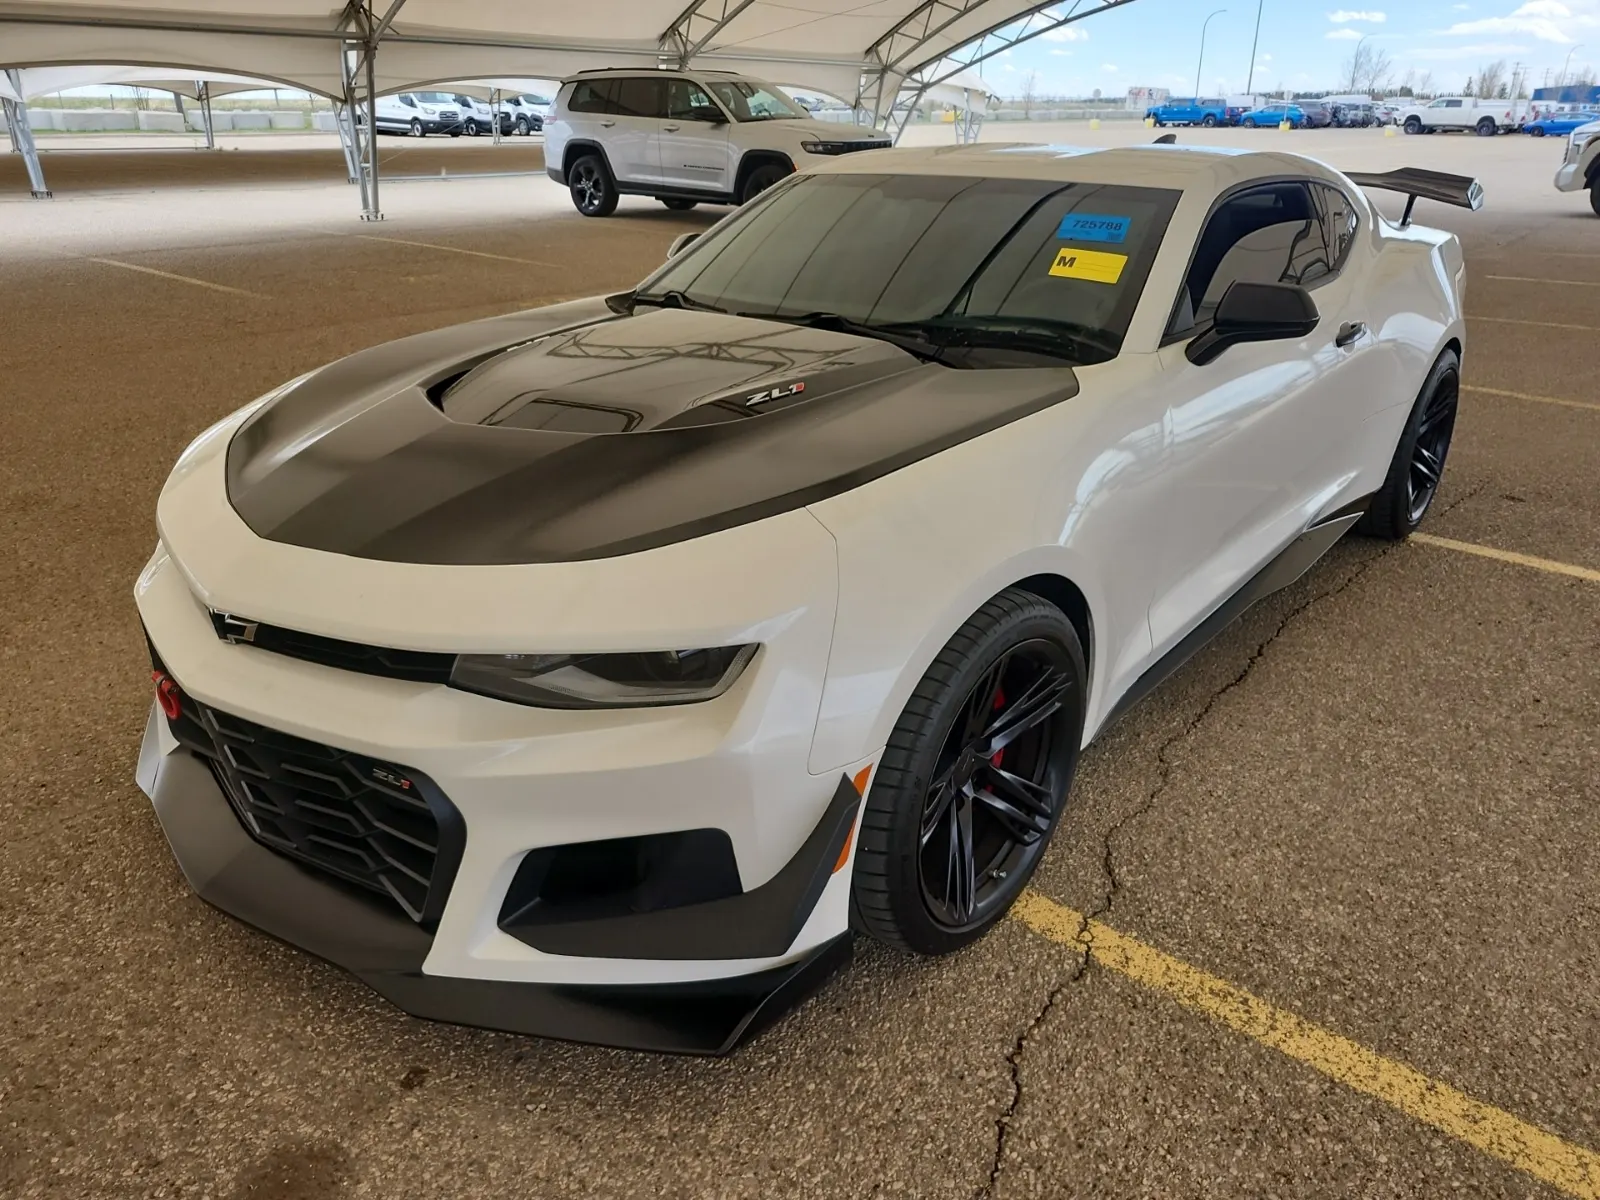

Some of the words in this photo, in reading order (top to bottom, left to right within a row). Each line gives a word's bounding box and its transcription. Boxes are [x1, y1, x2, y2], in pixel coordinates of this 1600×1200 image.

[1072, 219, 1123, 231] 725788
[1056, 255, 1077, 268] M
[745, 382, 805, 407] ZL1
[372, 768, 411, 790] ZL1
